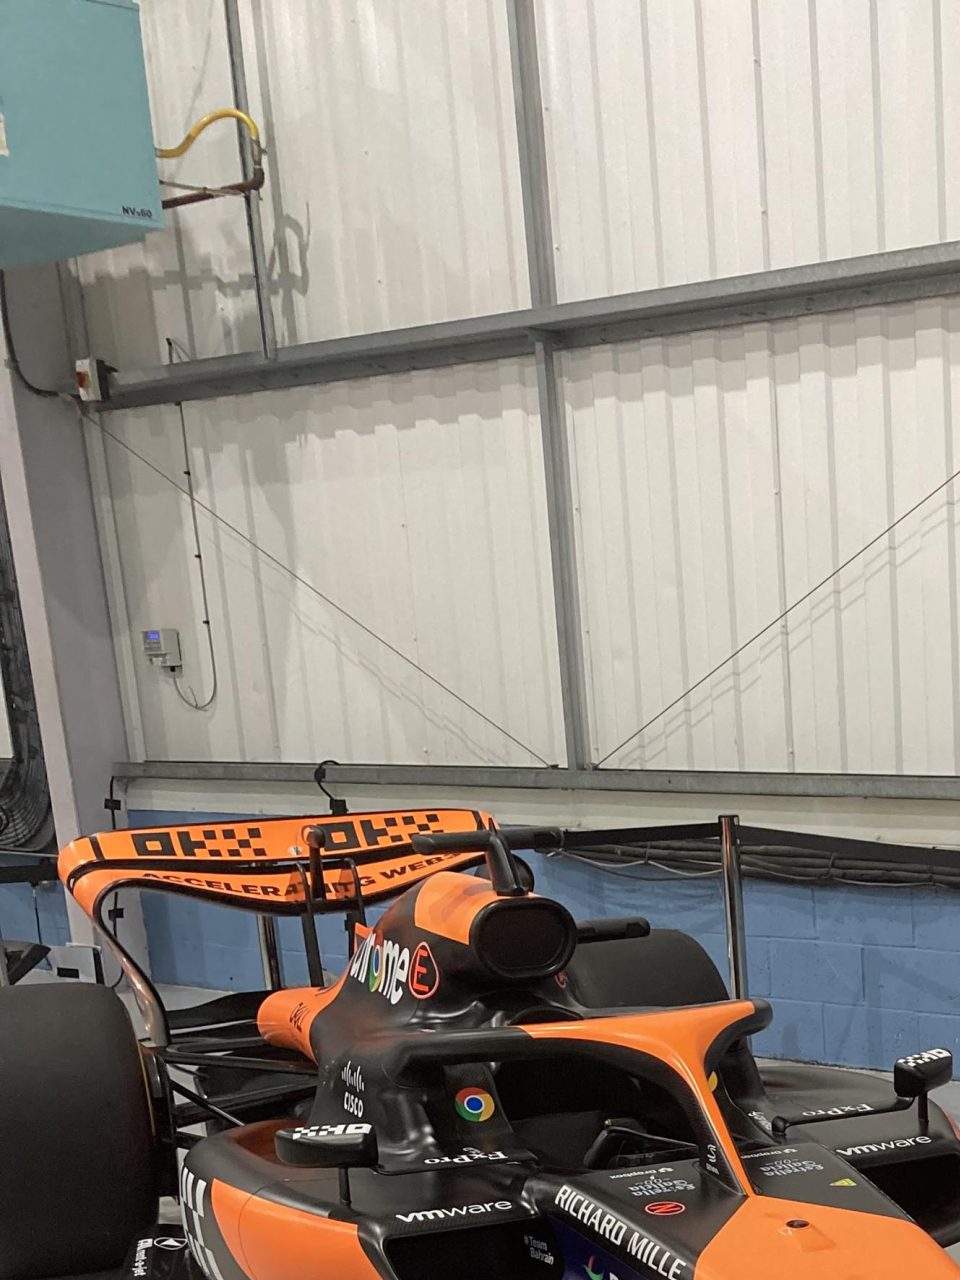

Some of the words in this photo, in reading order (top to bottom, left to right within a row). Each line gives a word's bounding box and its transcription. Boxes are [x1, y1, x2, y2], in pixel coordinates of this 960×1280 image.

[802, 1103, 875, 1117] FxPro
[424, 1151, 508, 1164] FxPro
[836, 1135, 932, 1158] vmware
[395, 1200, 513, 1223] vmware
[555, 1184, 627, 1246] RICHARD
